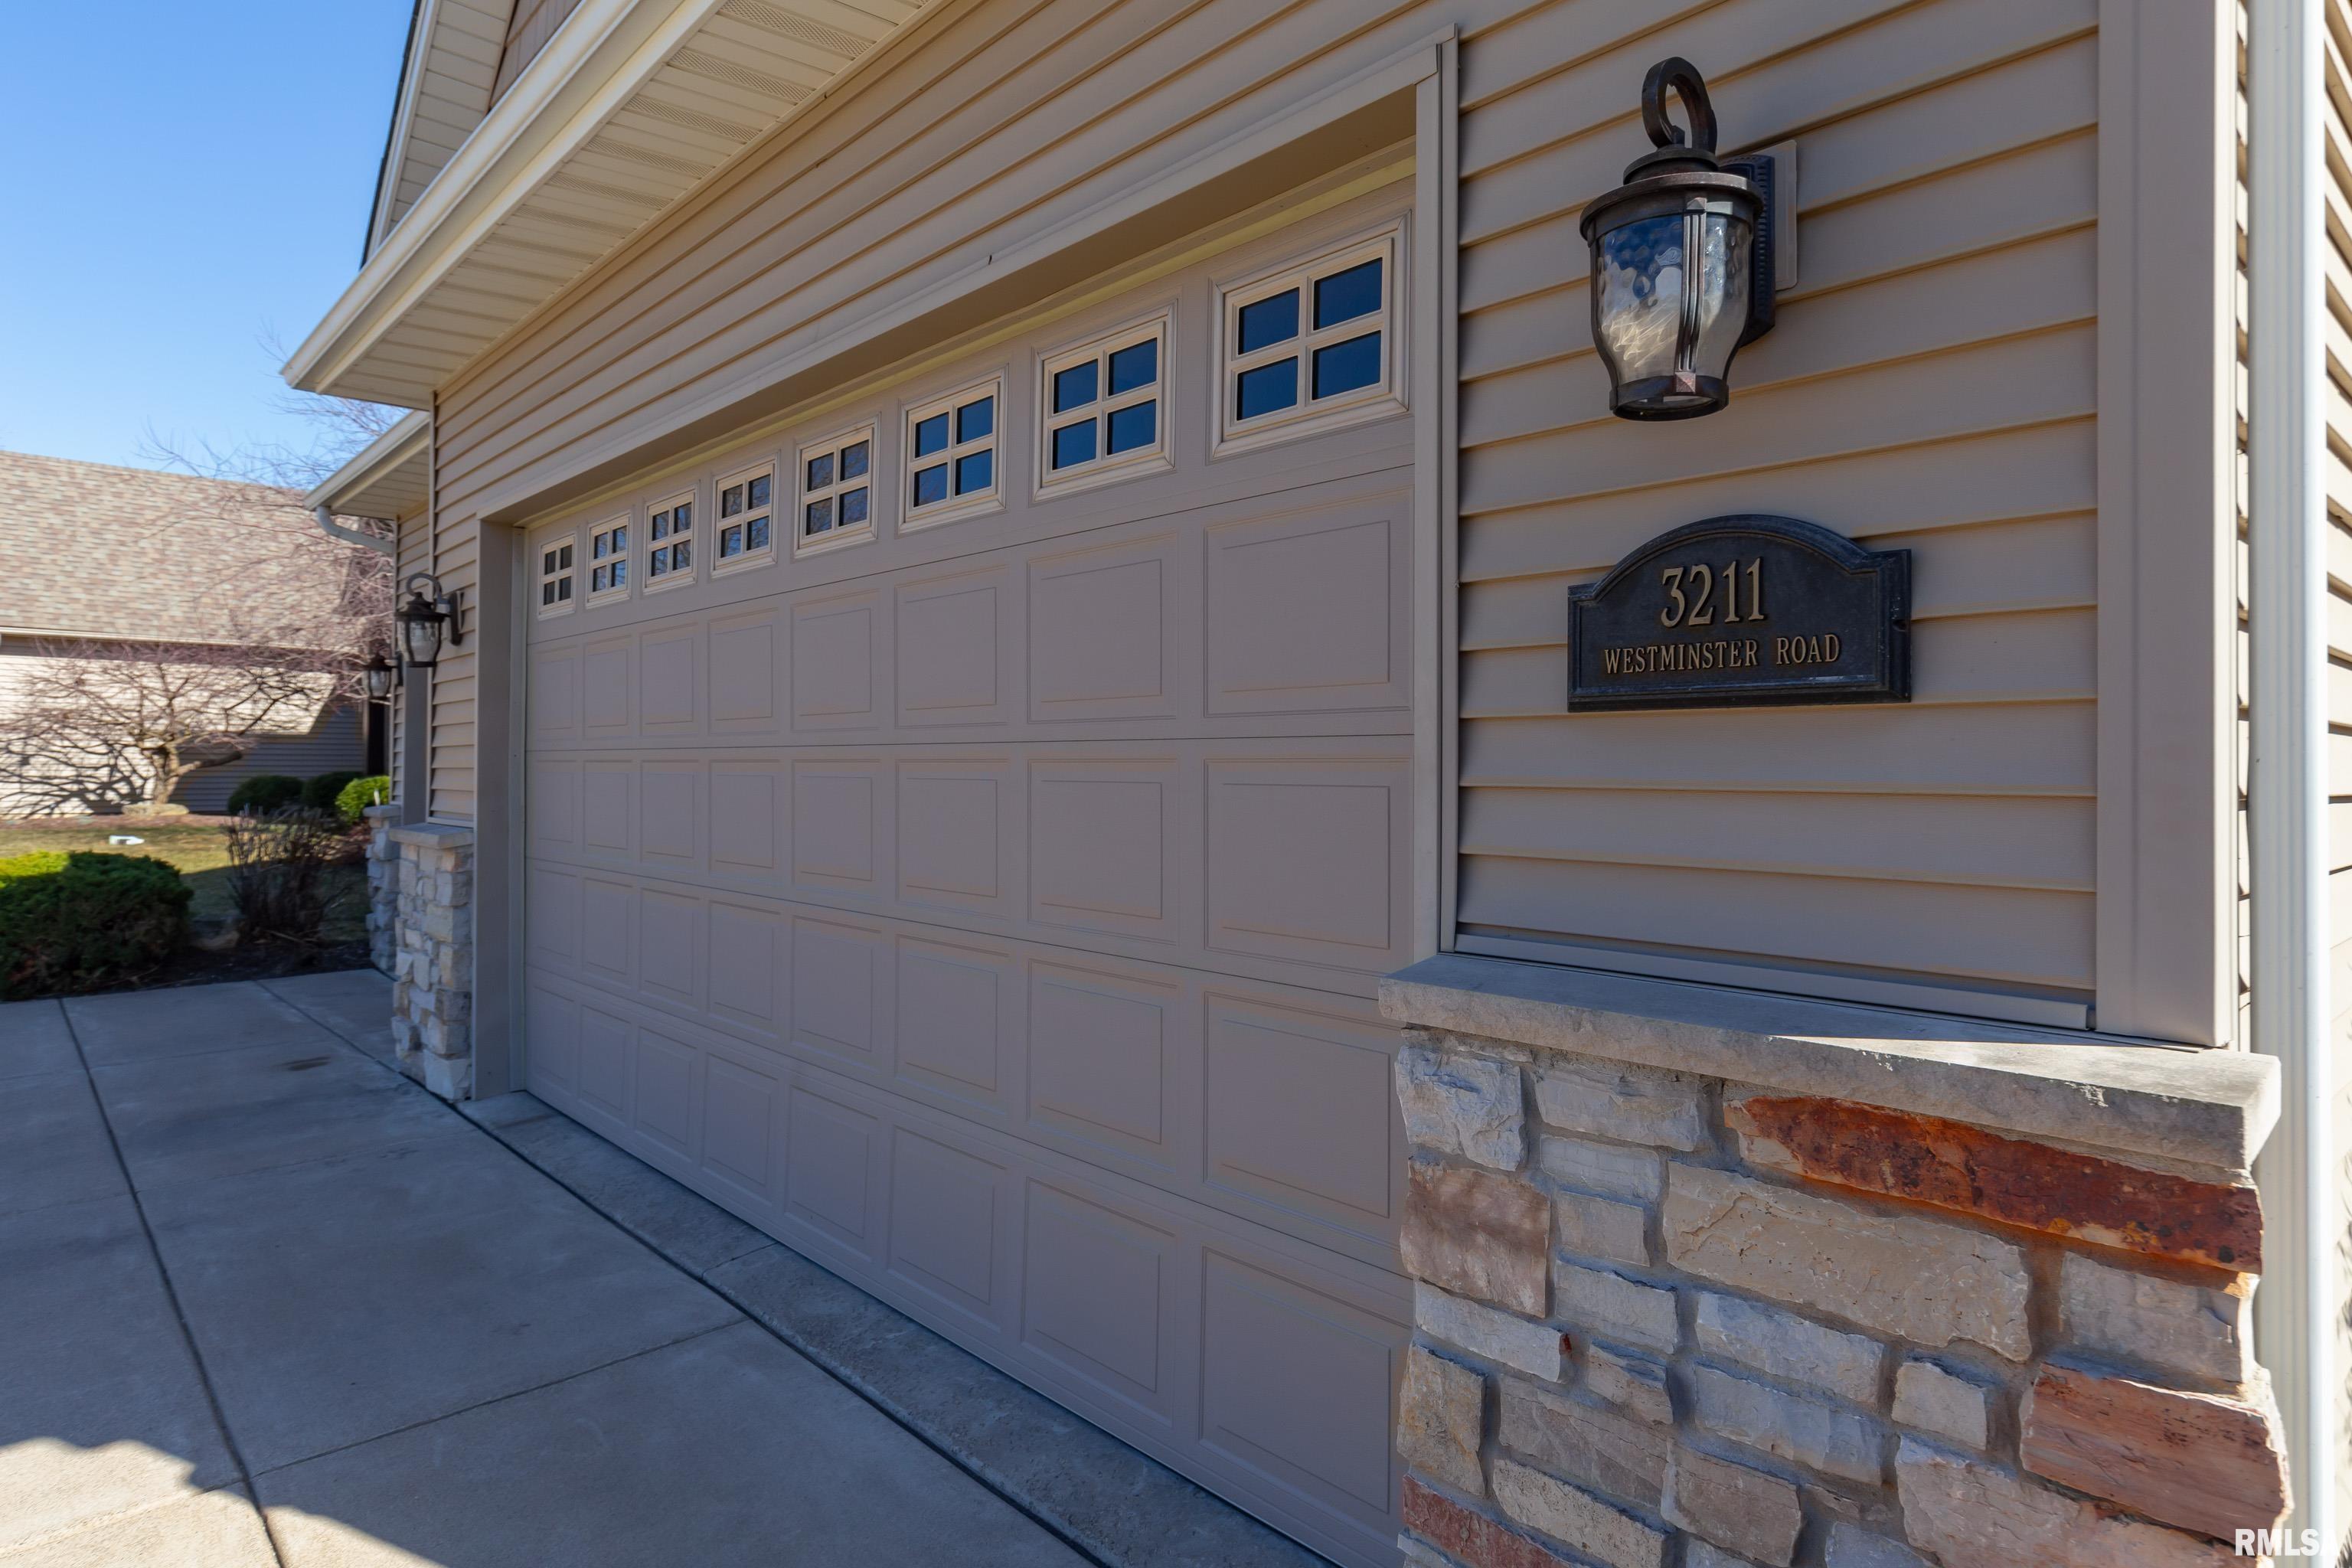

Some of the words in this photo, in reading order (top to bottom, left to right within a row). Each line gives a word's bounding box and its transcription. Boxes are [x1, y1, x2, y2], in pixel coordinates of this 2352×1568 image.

[1661, 557, 1766, 628] 3211
[1605, 639, 1759, 674] WESTMINSTER
[1776, 634, 1841, 665] ROAD
